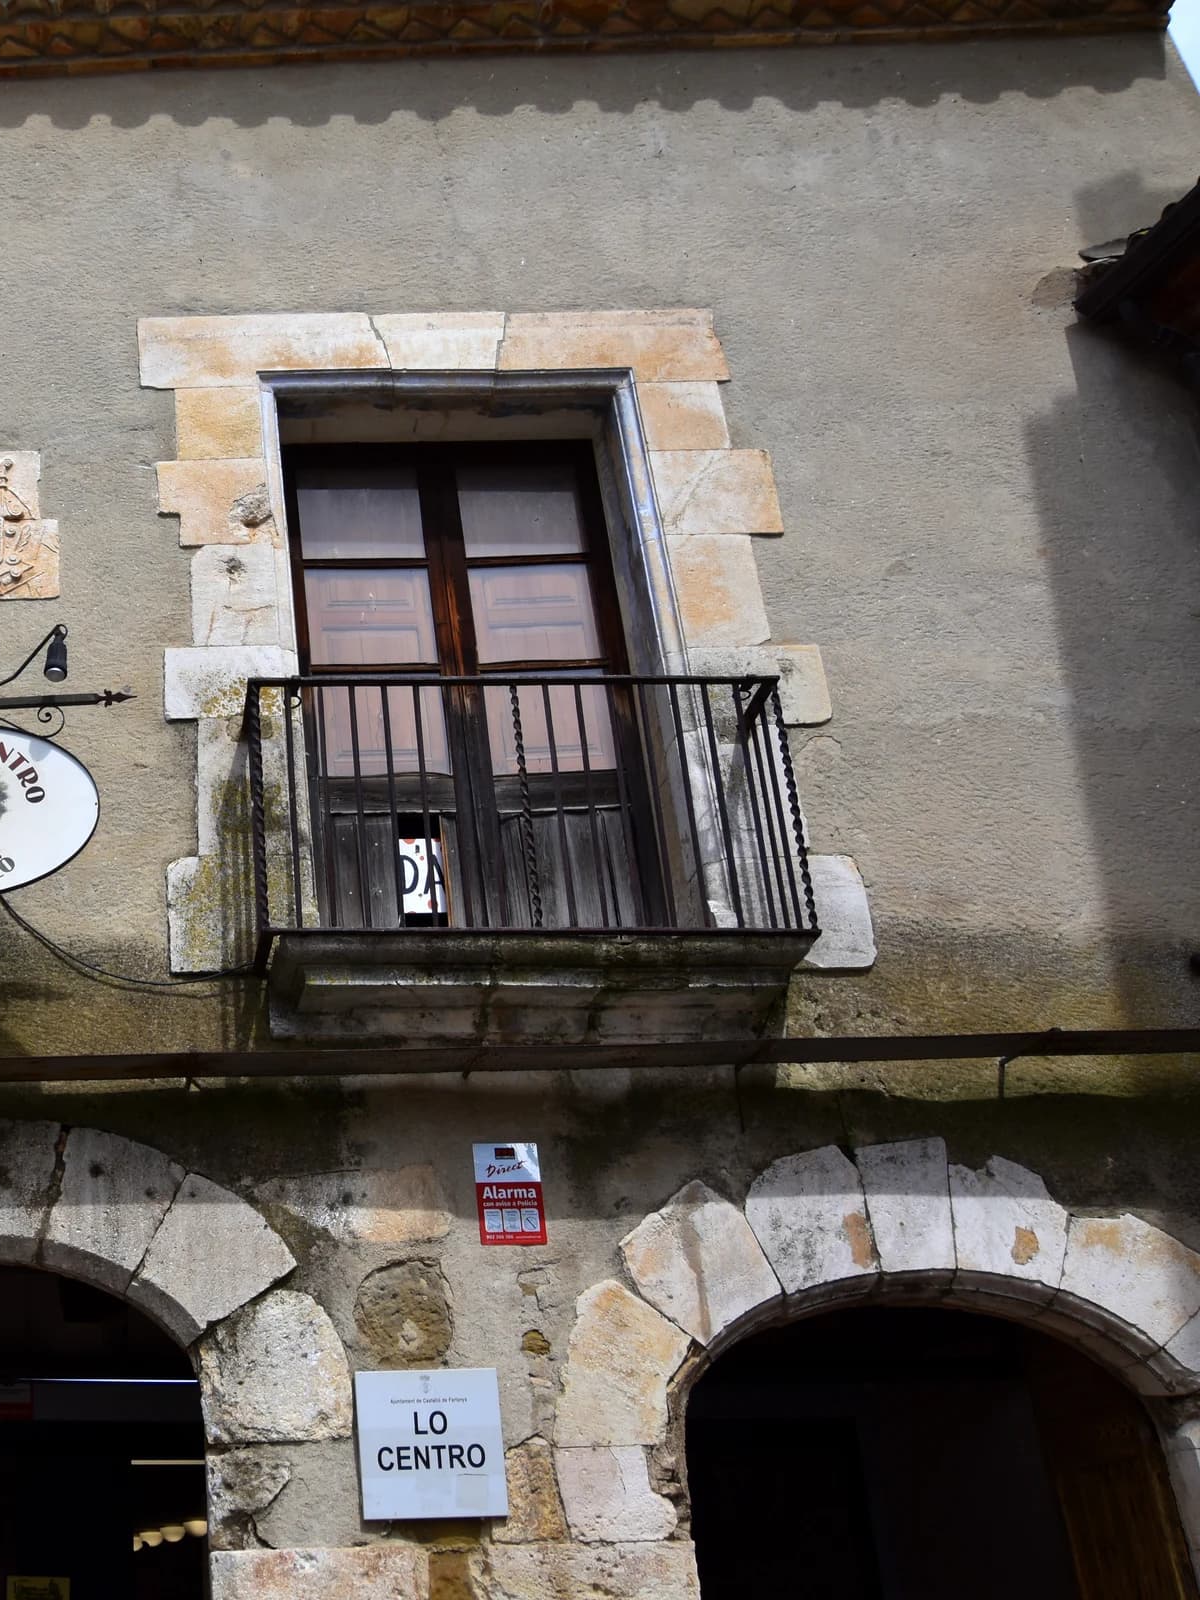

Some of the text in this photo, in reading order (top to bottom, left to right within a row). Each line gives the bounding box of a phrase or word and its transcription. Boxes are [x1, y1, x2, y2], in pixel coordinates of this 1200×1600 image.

[486, 1160, 528, 1178] Direct
[482, 1186, 536, 1199] Alarma
[413, 1410, 448, 1435] LO
[377, 1443, 486, 1471] CENTRO
